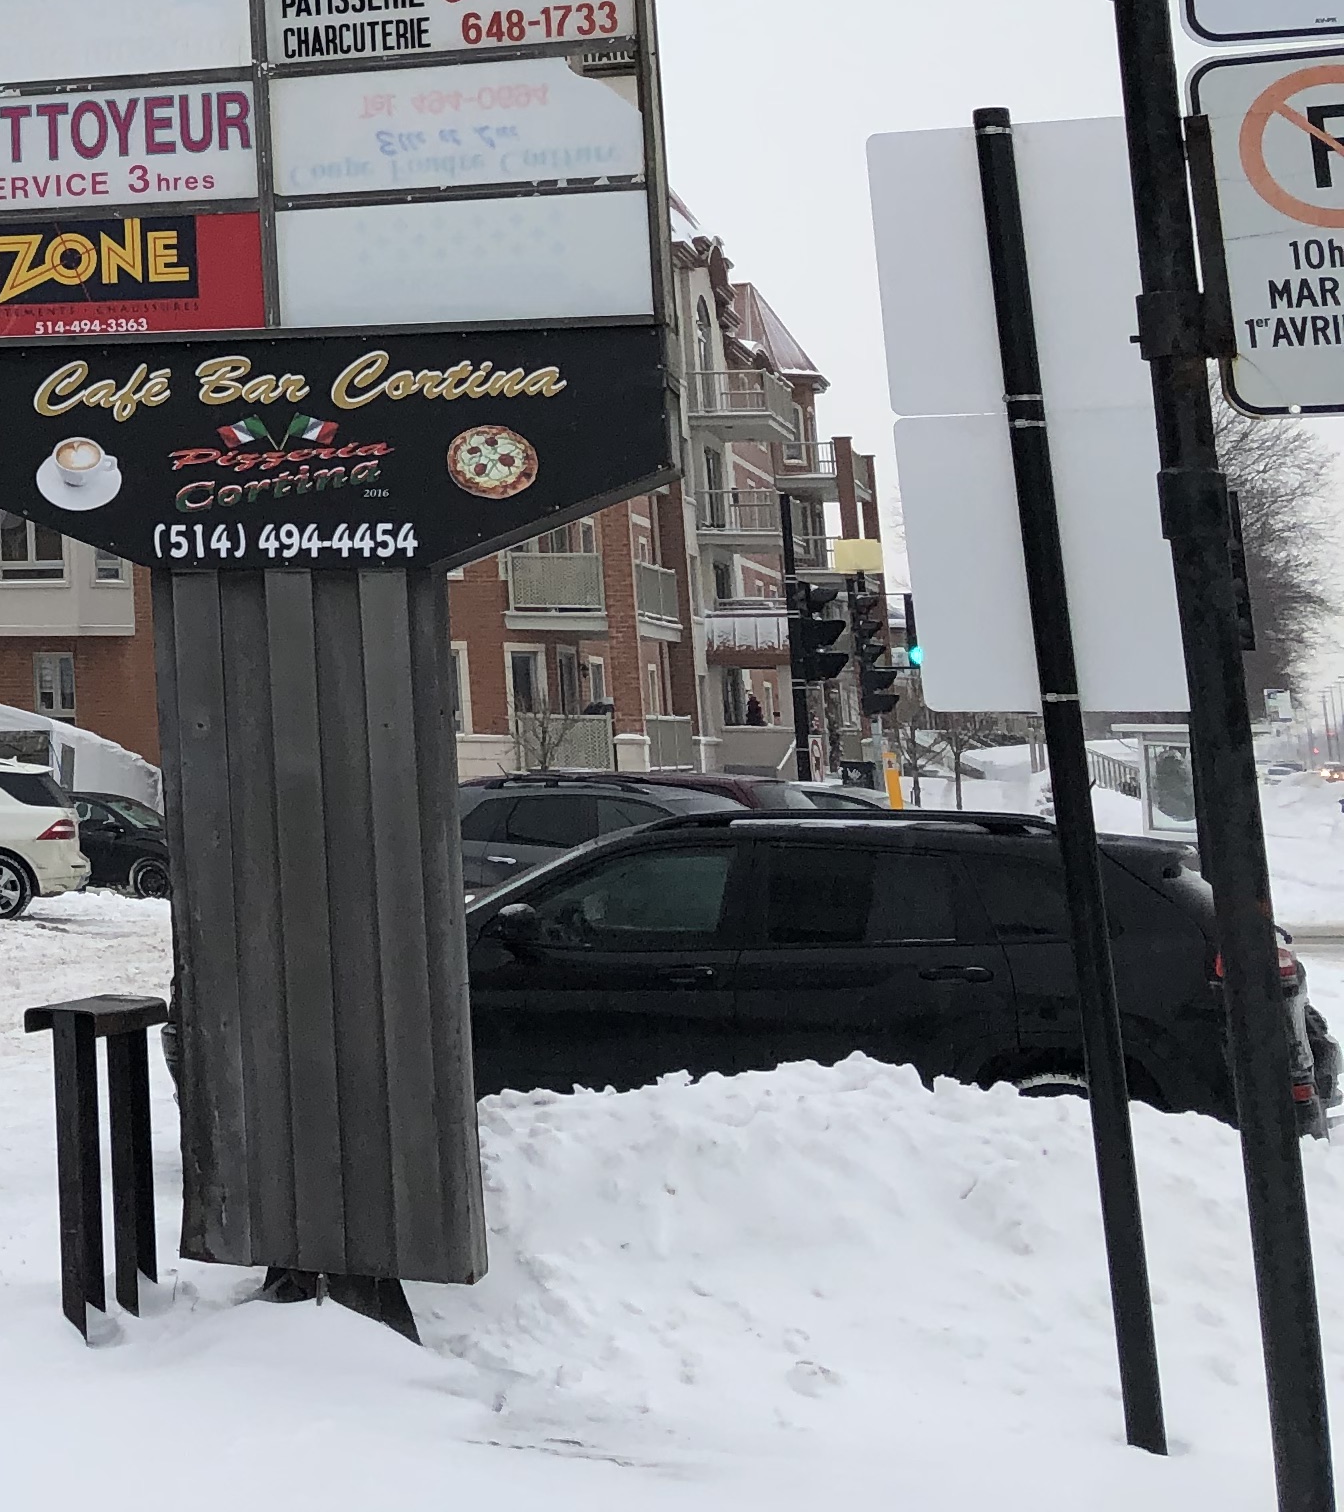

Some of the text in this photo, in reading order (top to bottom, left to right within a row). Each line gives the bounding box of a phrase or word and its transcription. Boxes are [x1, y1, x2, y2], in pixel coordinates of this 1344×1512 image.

[282, 17, 432, 61] CHARCUTERIE
[460, 0, 619, 44] 648-1733
[1268, 276, 1342, 309] MAR
[34, 317, 148, 335] 514-494-3363
[1272, 314, 1344, 348] AVRI
[33, 350, 568, 423] Café Bar Cortina
[169, 442, 396, 472] Pizzeria
[176, 460, 382, 513] Cortina
[363, 488, 390, 498] 2016
[153, 522, 419, 558] (514) 494-4454
